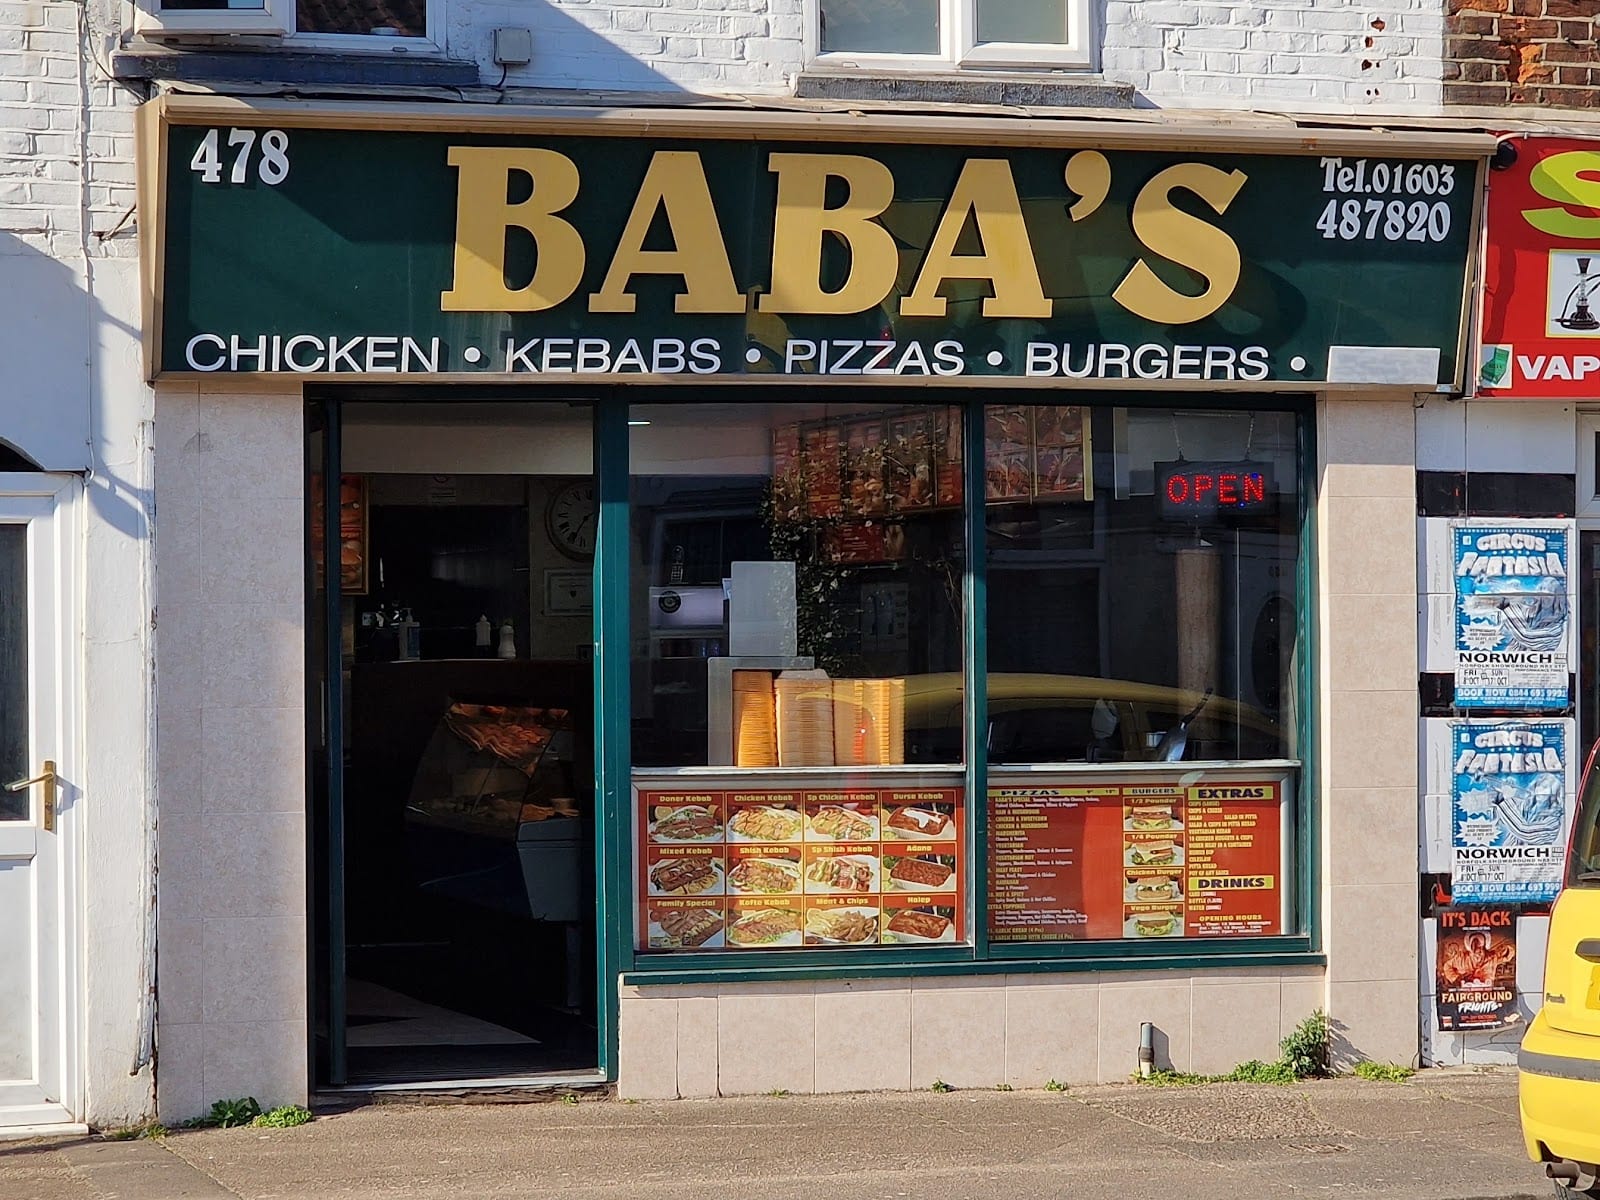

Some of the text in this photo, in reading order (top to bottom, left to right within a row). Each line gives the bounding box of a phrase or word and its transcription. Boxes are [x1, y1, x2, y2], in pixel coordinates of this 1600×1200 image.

[190, 128, 290, 184] 478
[1320, 157, 1455, 196] Tel.01603
[1316, 200, 1451, 242] 487820
[440, 146, 1248, 324] BABA'S
[185, 334, 1270, 380] CHICKEN KEBABS PIZZAS BURGERS
[1166, 474, 1265, 504] OPEN
[1477, 534, 1546, 551] CIRCUS
[1460, 652, 1552, 663] NORWICH
[1475, 730, 1543, 748] CIRCUS
[734, 794, 793, 802] Chicken Kebab
[819, 793, 850, 802] Chicken
[852, 793, 875, 802] Kebab
[918, 793, 943, 801] Kebab
[1198, 788, 1264, 798] EXTRAS
[659, 795, 712, 803] Doner Kebab
[660, 847, 712, 855] Mixed Kebab
[739, 846, 789, 854] Shish Kebab
[823, 846, 844, 854] Shish
[846, 846, 873, 854] Kebab
[1457, 848, 1549, 858] NORWICH
[1198, 878, 1264, 888] DRINKS
[657, 900, 716, 908] Family Special
[816, 898, 837, 906] Meat
[846, 898, 868, 906] Chips
[1442, 912, 1466, 927] IT'S
[1442, 992, 1513, 1003] FAIRGROUND
[1458, 1001, 1498, 1014] FRIGHTS
